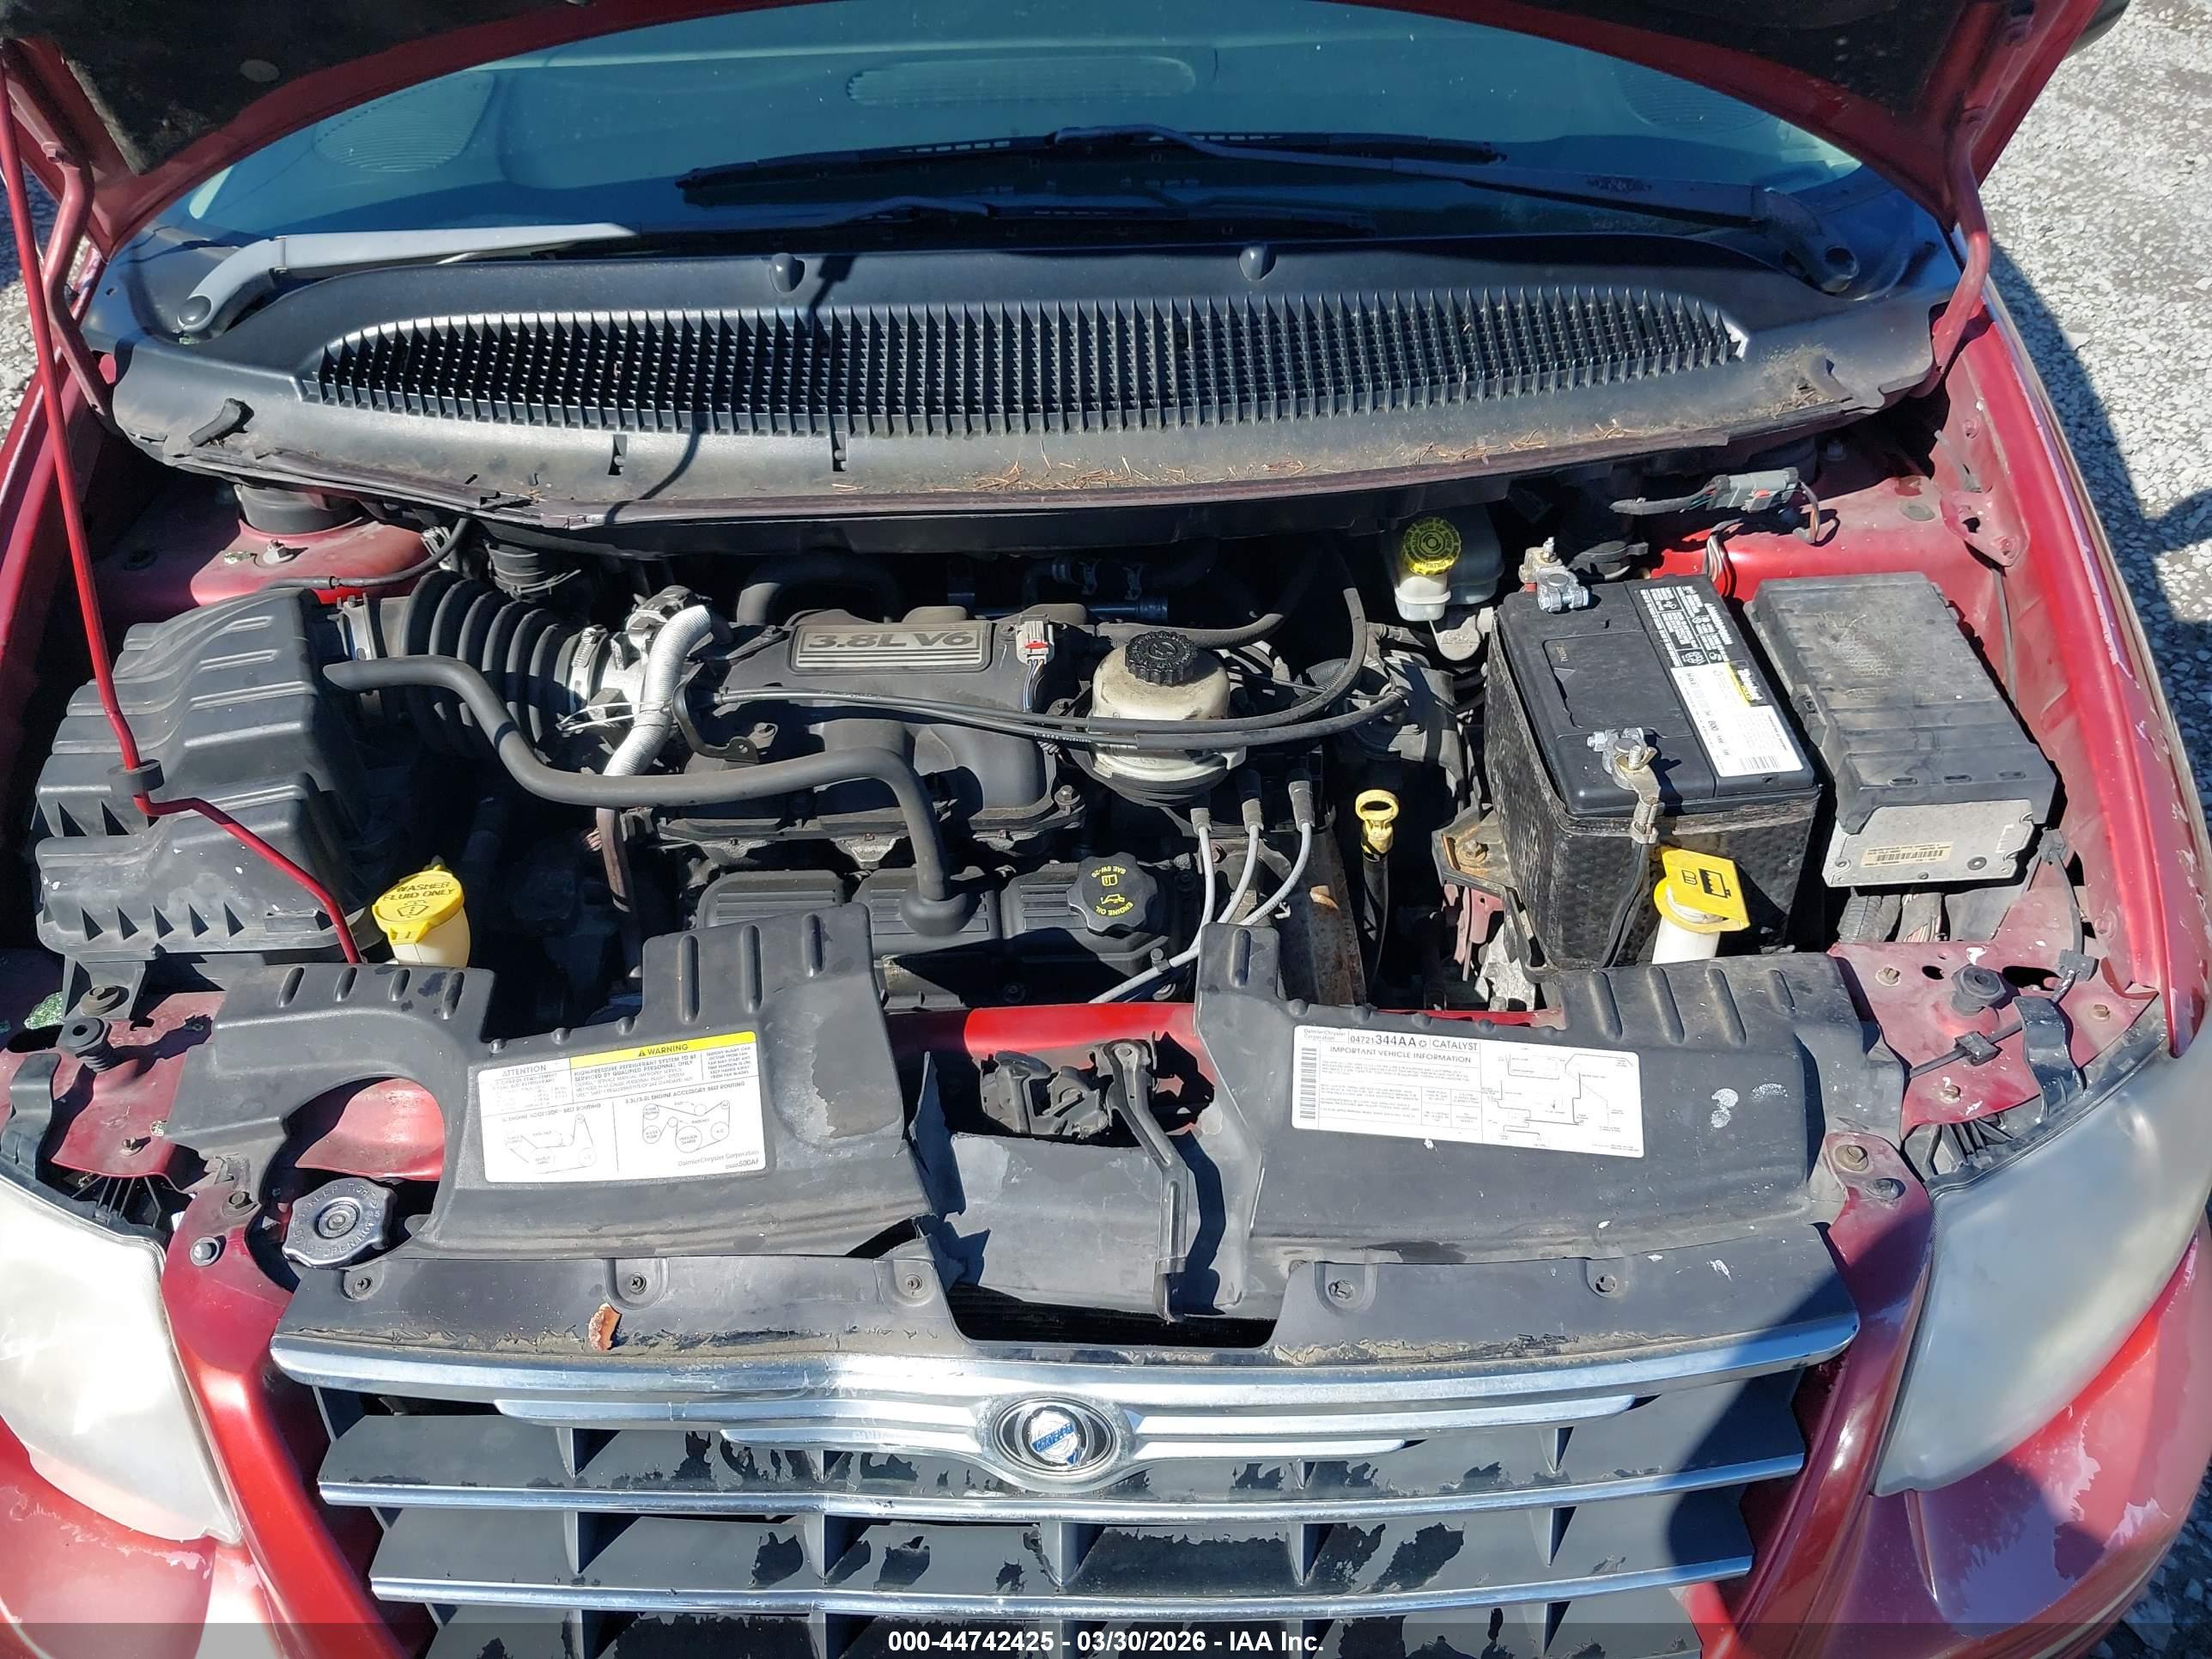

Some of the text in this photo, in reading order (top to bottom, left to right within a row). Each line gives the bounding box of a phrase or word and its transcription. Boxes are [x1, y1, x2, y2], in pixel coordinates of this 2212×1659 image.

[808, 631, 974, 649] 3.8L V6
[1091, 866, 1127, 878] SAE 5W-20
[396, 882, 451, 892] WASHER
[382, 889, 457, 901] FLUID ONLY
[1095, 902, 1133, 916] ENGINE OIL
[647, 1043, 689, 1055] WARNING
[1431, 1039, 1478, 1051] CATALYST
[1329, 1046, 1472, 1063] IMPORTANT VEHICLE INFORMATION
[501, 1064, 547, 1078] ATTENTION
[574, 1073, 602, 1082] SERVICED
[612, 1067, 641, 1077] QUALIFIED
[673, 1087, 706, 1097] ACCESSORY
[720, 1081, 745, 1090] ROUTING
